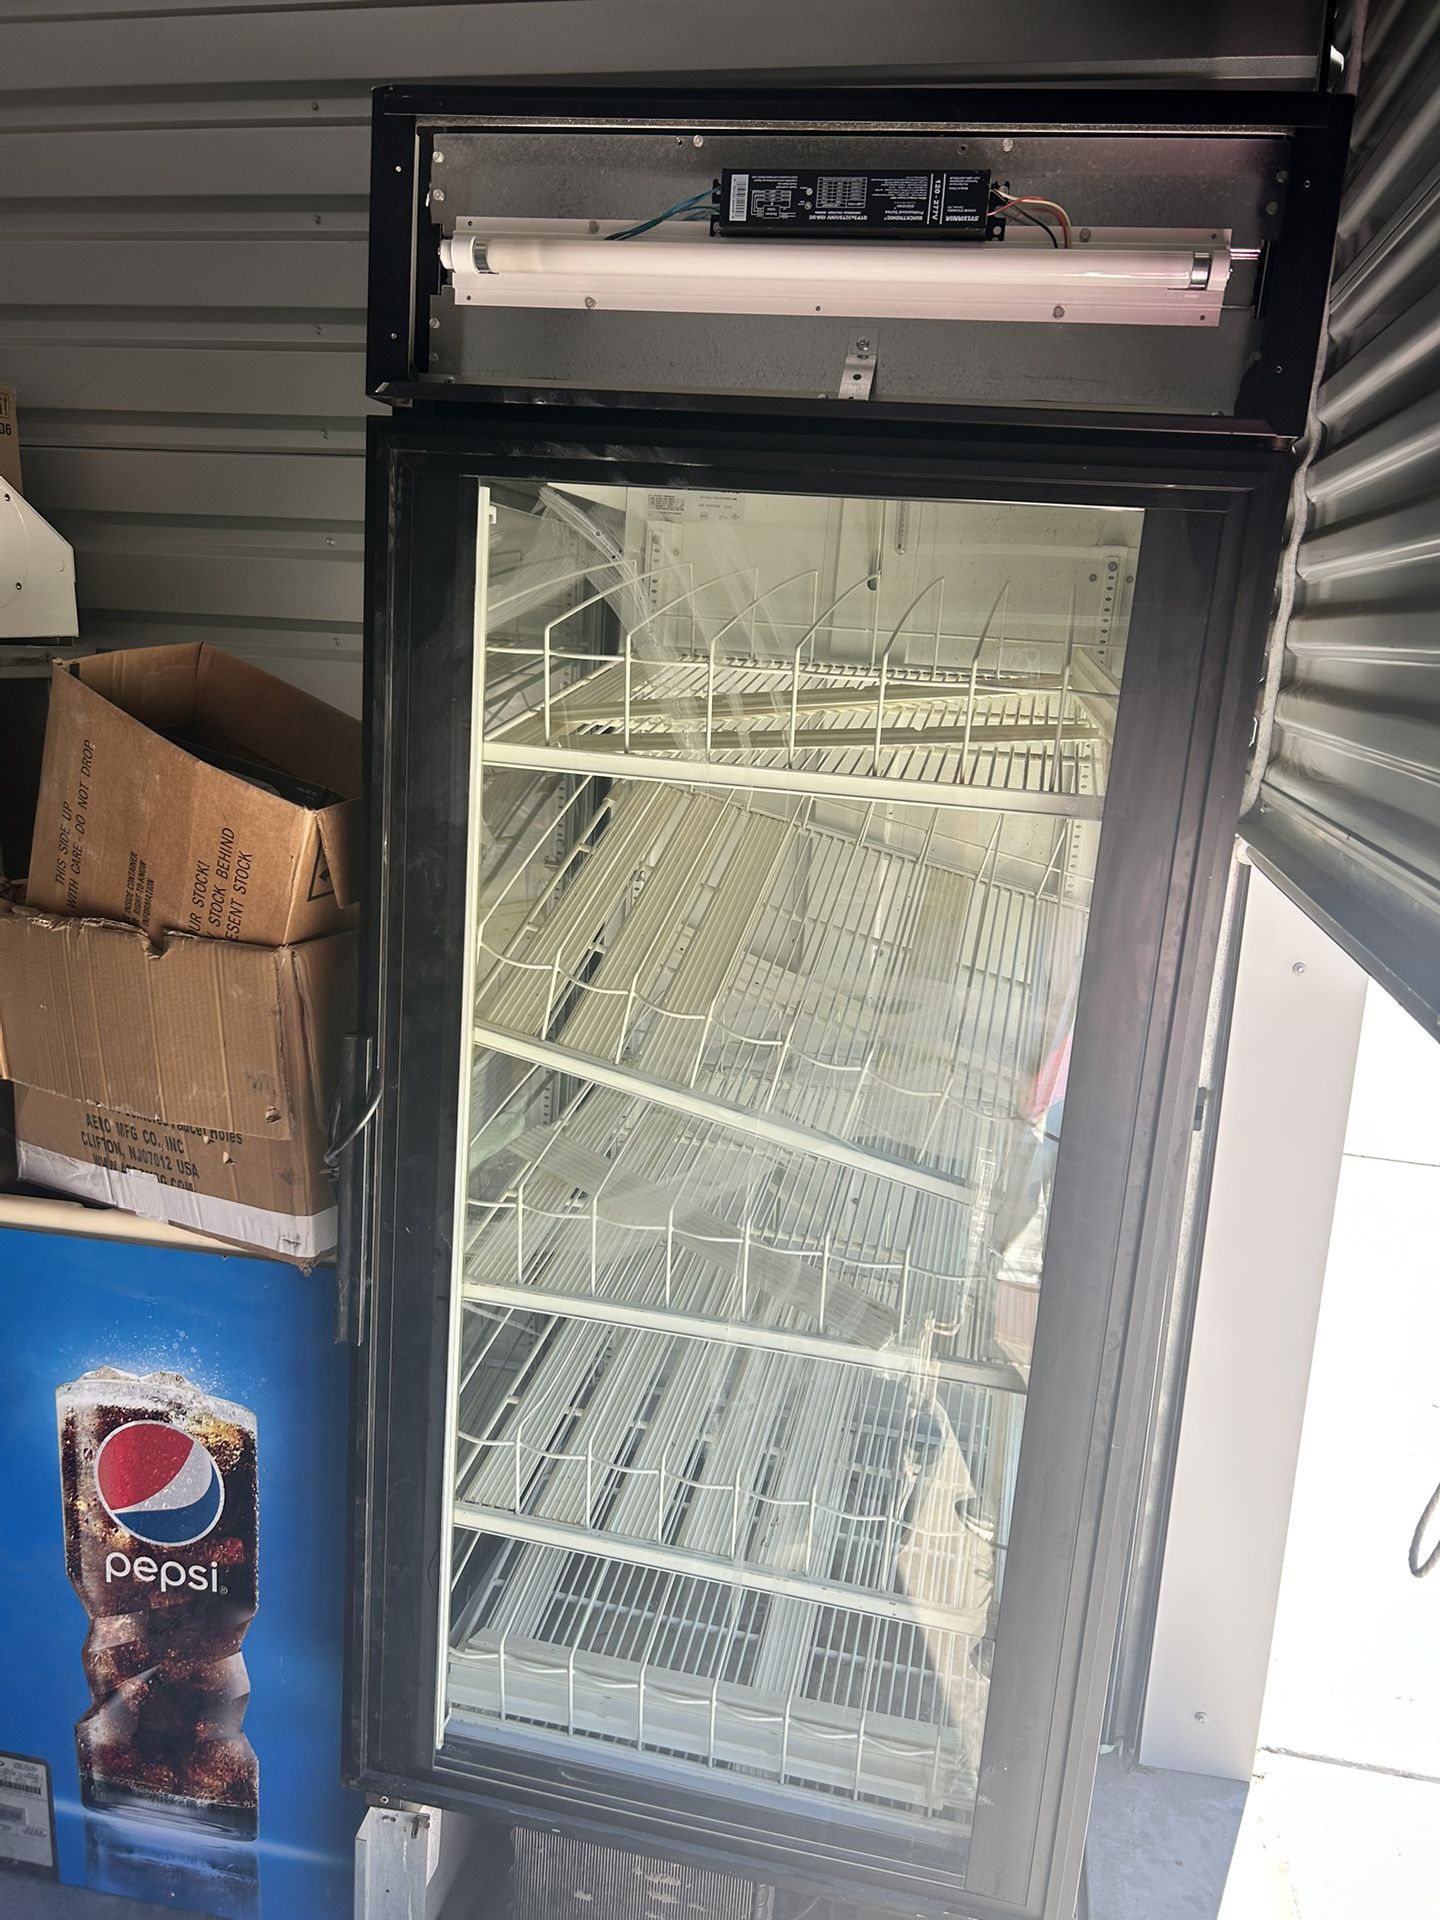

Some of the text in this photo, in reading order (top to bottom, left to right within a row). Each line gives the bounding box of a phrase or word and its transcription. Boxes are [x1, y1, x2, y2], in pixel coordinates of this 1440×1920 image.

[932, 199, 940, 220] 277V
[80, 739, 94, 777] DROP
[77, 780, 89, 810] NOT
[55, 801, 73, 885] THIS SIDE UP
[74, 814, 86, 835] DO
[70, 842, 82, 875] CARE
[127, 851, 138, 890] CONTAINER
[216, 827, 235, 880] BEHIND
[232, 850, 253, 895] STOCK
[66, 878, 80, 909] WITH
[142, 877, 154, 927] INFORMATION
[191, 860, 211, 908] STOCK!
[208, 884, 227, 927] STOCK
[80, 1131, 200, 1179] CLIFTON, NJ07012 USA
[115, 1121, 138, 1141] MFG
[165, 1135, 185, 1154] INC
[105, 1551, 218, 1593] pepsi
